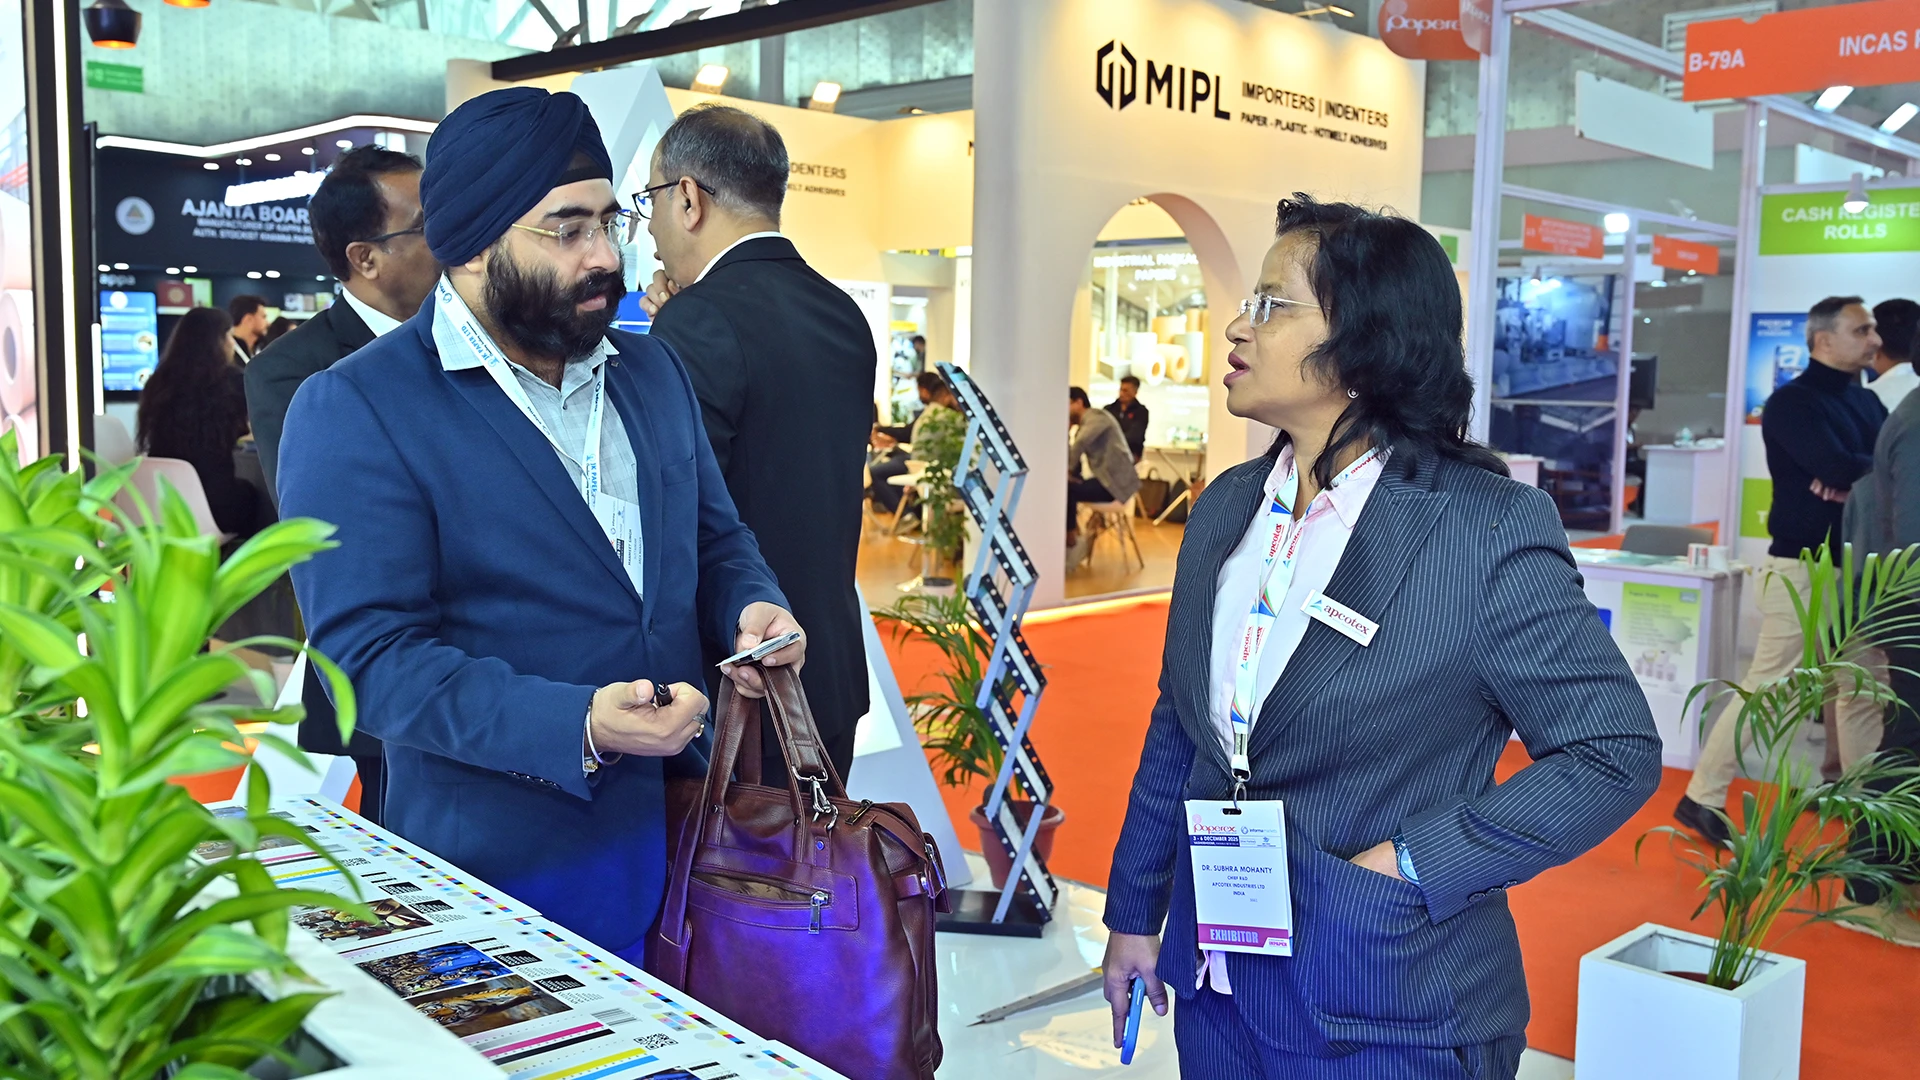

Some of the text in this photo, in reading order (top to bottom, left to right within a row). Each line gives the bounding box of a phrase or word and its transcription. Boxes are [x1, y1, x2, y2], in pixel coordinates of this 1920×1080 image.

[1688, 48, 1745, 72] B-79A
[1838, 30, 1908, 57] INCAS
[1146, 60, 1230, 121] MIPL
[1242, 81, 1315, 112] IMPORTERS
[1325, 101, 1389, 128] INDENTERS
[1241, 112, 1268, 127] PAPER
[1275, 119, 1308, 135] PLASTIC
[790, 162, 847, 180] DENTERS
[181, 198, 311, 224] AJANTA BOAR
[1781, 202, 1920, 223] CASH RGISTE
[1823, 223, 1888, 240] ROLLS
[1269, 523, 1282, 557] apcotex
[1323, 604, 1370, 635] apcotex
[1240, 866, 1273, 874] MOHANTY
[1209, 928, 1259, 944] EXHIBITOR
